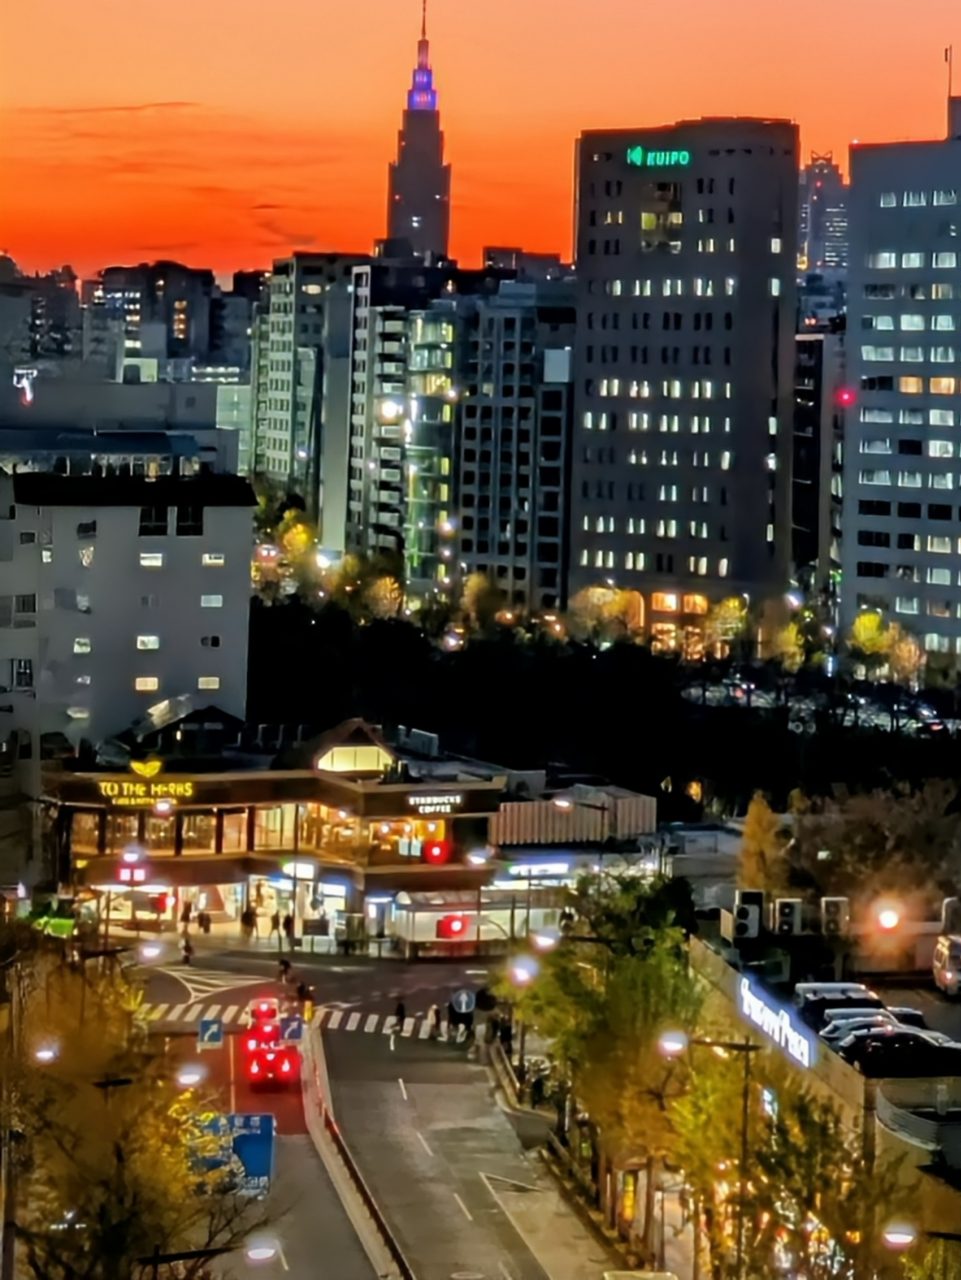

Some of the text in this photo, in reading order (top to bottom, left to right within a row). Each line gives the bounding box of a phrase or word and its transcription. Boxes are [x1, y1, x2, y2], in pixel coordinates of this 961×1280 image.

[647, 151, 690, 166] KUIPO
[99, 782, 119, 797] TO
[409, 795, 461, 805] STARBUCKS
[418, 804, 451, 814] COFFEE
